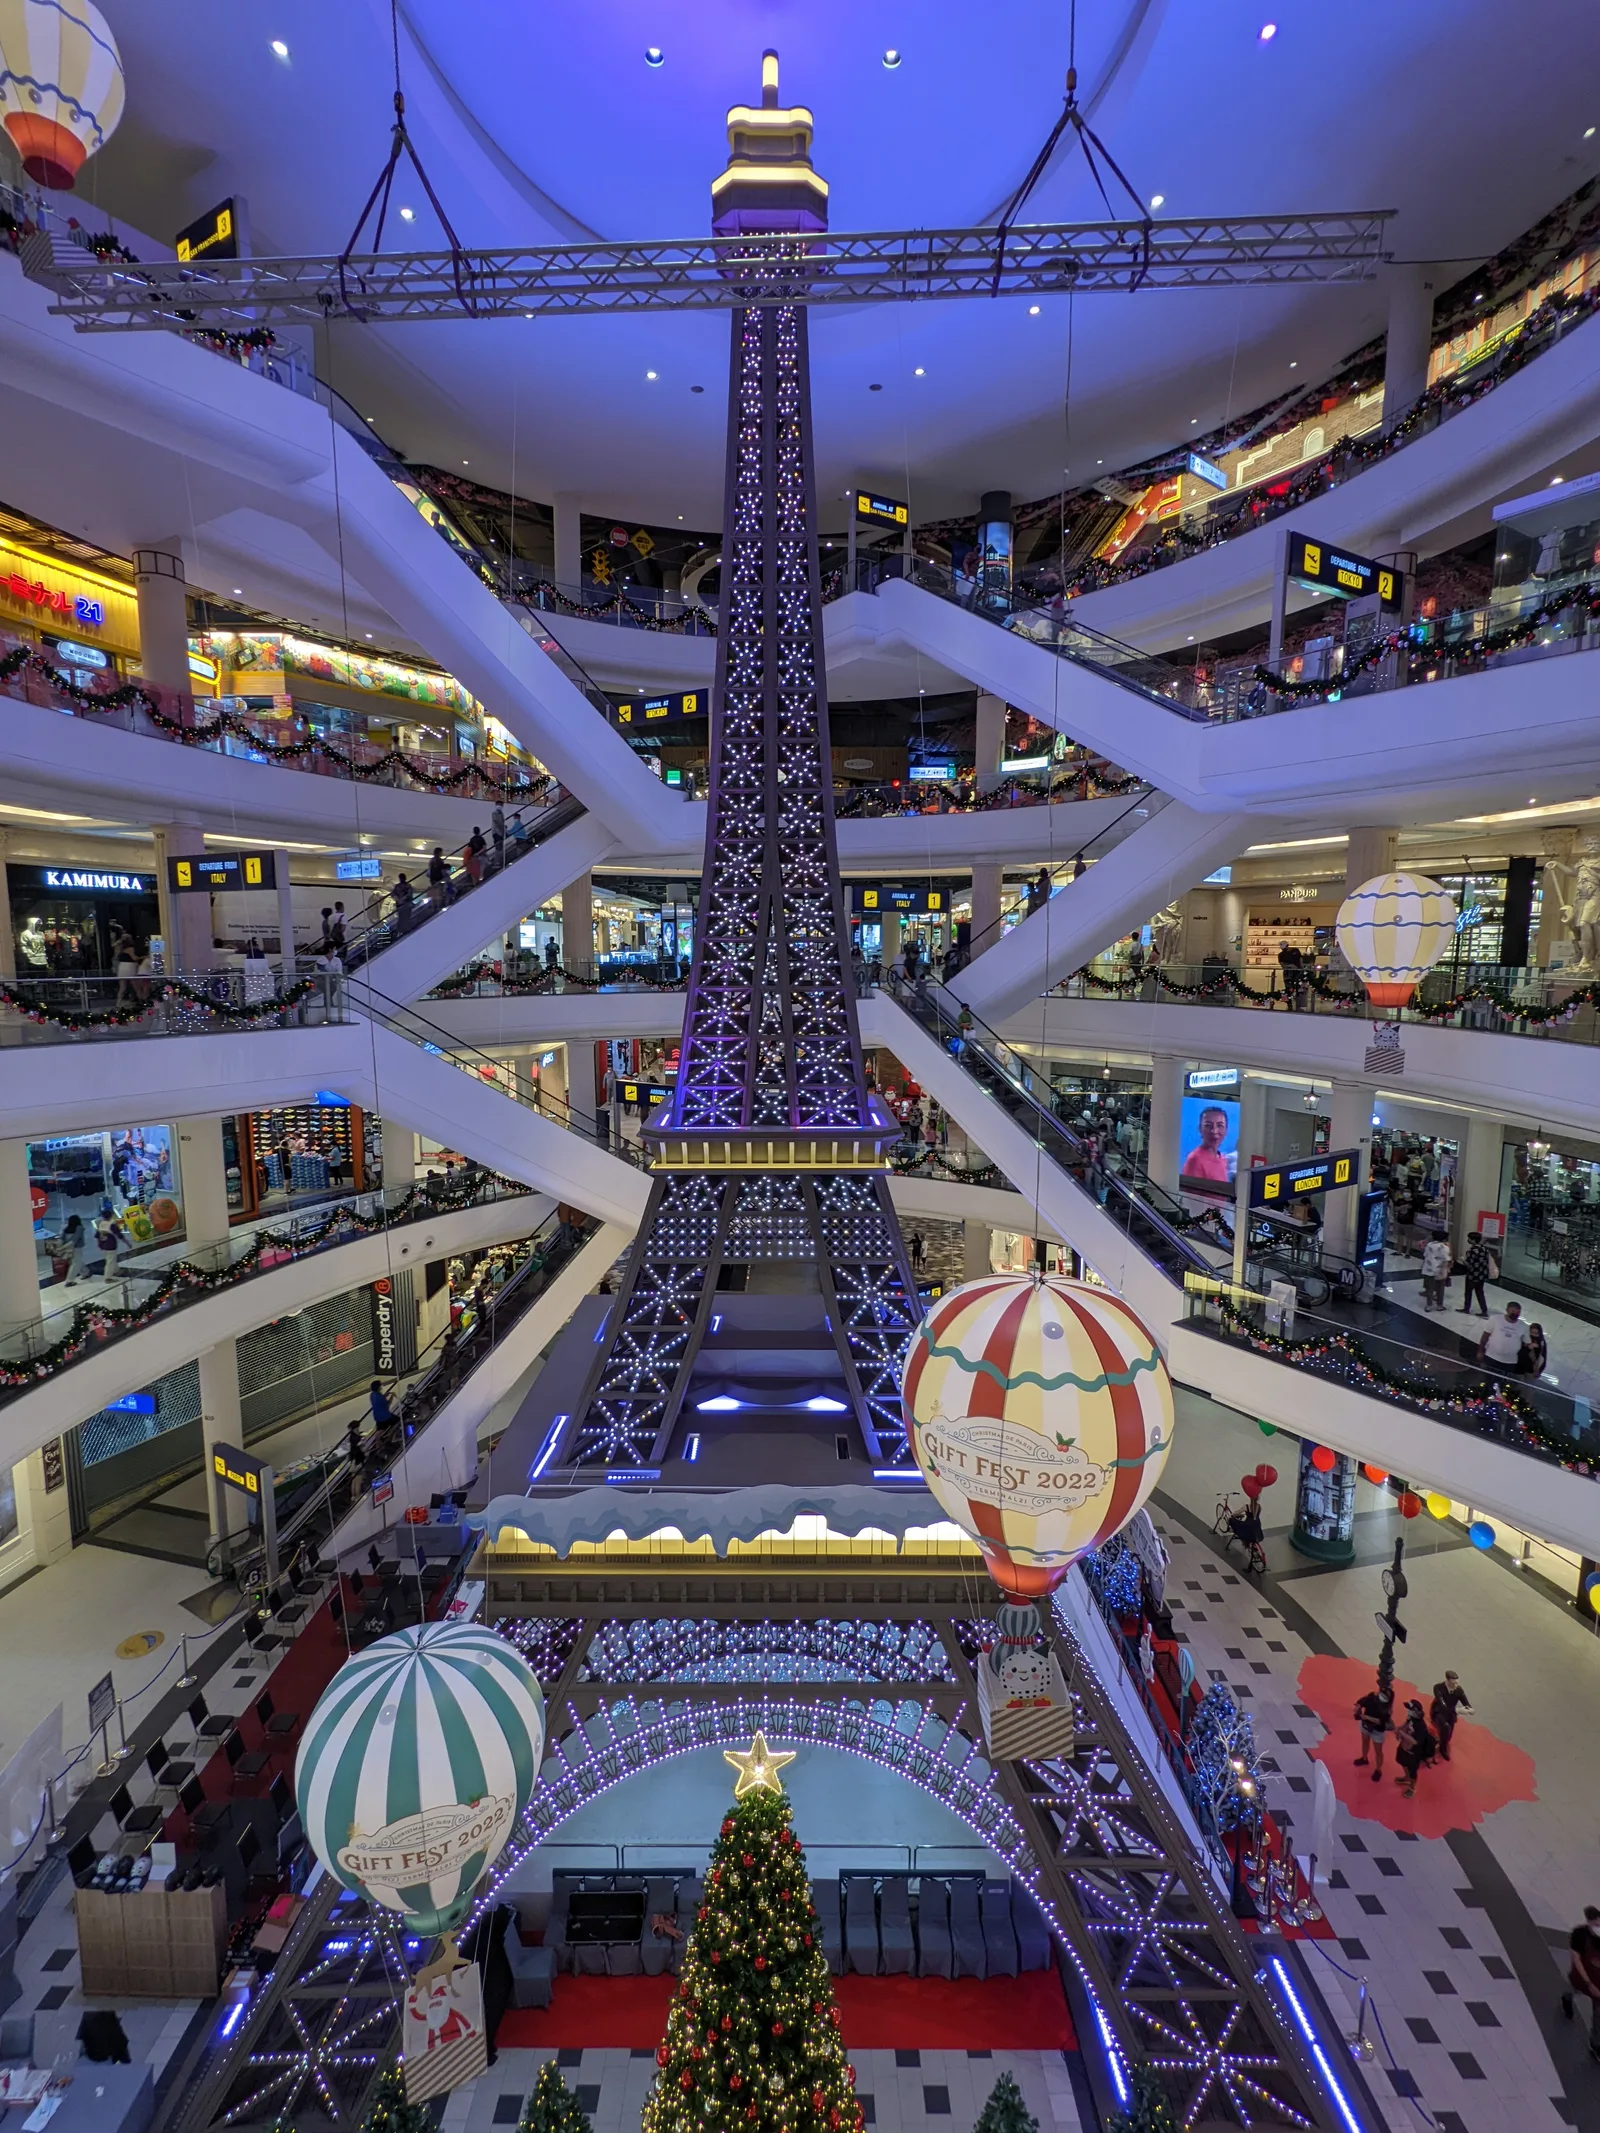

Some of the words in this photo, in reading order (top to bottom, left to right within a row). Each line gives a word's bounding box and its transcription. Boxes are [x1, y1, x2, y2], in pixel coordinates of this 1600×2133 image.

[221, 216, 227, 233] 3
[899, 510, 904, 520] 3
[1330, 555, 1357, 573] DEPARTURE
[1357, 565, 1371, 577] FROM
[1340, 571, 1360, 587] TOKYO
[1382, 576, 1389, 594] 2
[77, 596, 103, 622] 21
[686, 698, 693, 710] 2
[948, 769, 954, 777] 2
[199, 861, 224, 871] DEPARTURE
[224, 860, 238, 870] FROM
[251, 861, 256, 879] 1
[46, 871, 143, 891] KAMIMURA
[211, 872, 227, 884] ITALY
[891, 892, 909, 900] ARRIVAL
[931, 896, 936, 906] 1
[896, 900, 911, 908] ITALY
[1192, 1075, 1198, 1085] M
[1289, 1168, 1315, 1180] DEPARTURE
[1315, 1165, 1329, 1175] FROM
[1338, 1163, 1347, 1179] M
[1297, 1177, 1320, 1191] LONDON
[32, 1197, 46, 1209] LE
[1341, 1270, 1354, 1285] M
[972, 1430, 1004, 1440] CHRISTMAS
[1005, 1434, 1014, 1442] DE
[1015, 1438, 1033, 1451] PARIS
[924, 1432, 968, 1468] GIFT
[975, 1455, 1030, 1491] FEST
[1036, 1472, 1096, 1490] 2022
[249, 1476, 254, 1488] G
[249, 1570, 258, 1584] G
[344, 1853, 395, 1872] GIFT
[401, 1840, 452, 1869] FEST
[458, 1807, 504, 1847] 2022
[394, 1825, 425, 1840] CHRISTMAS
